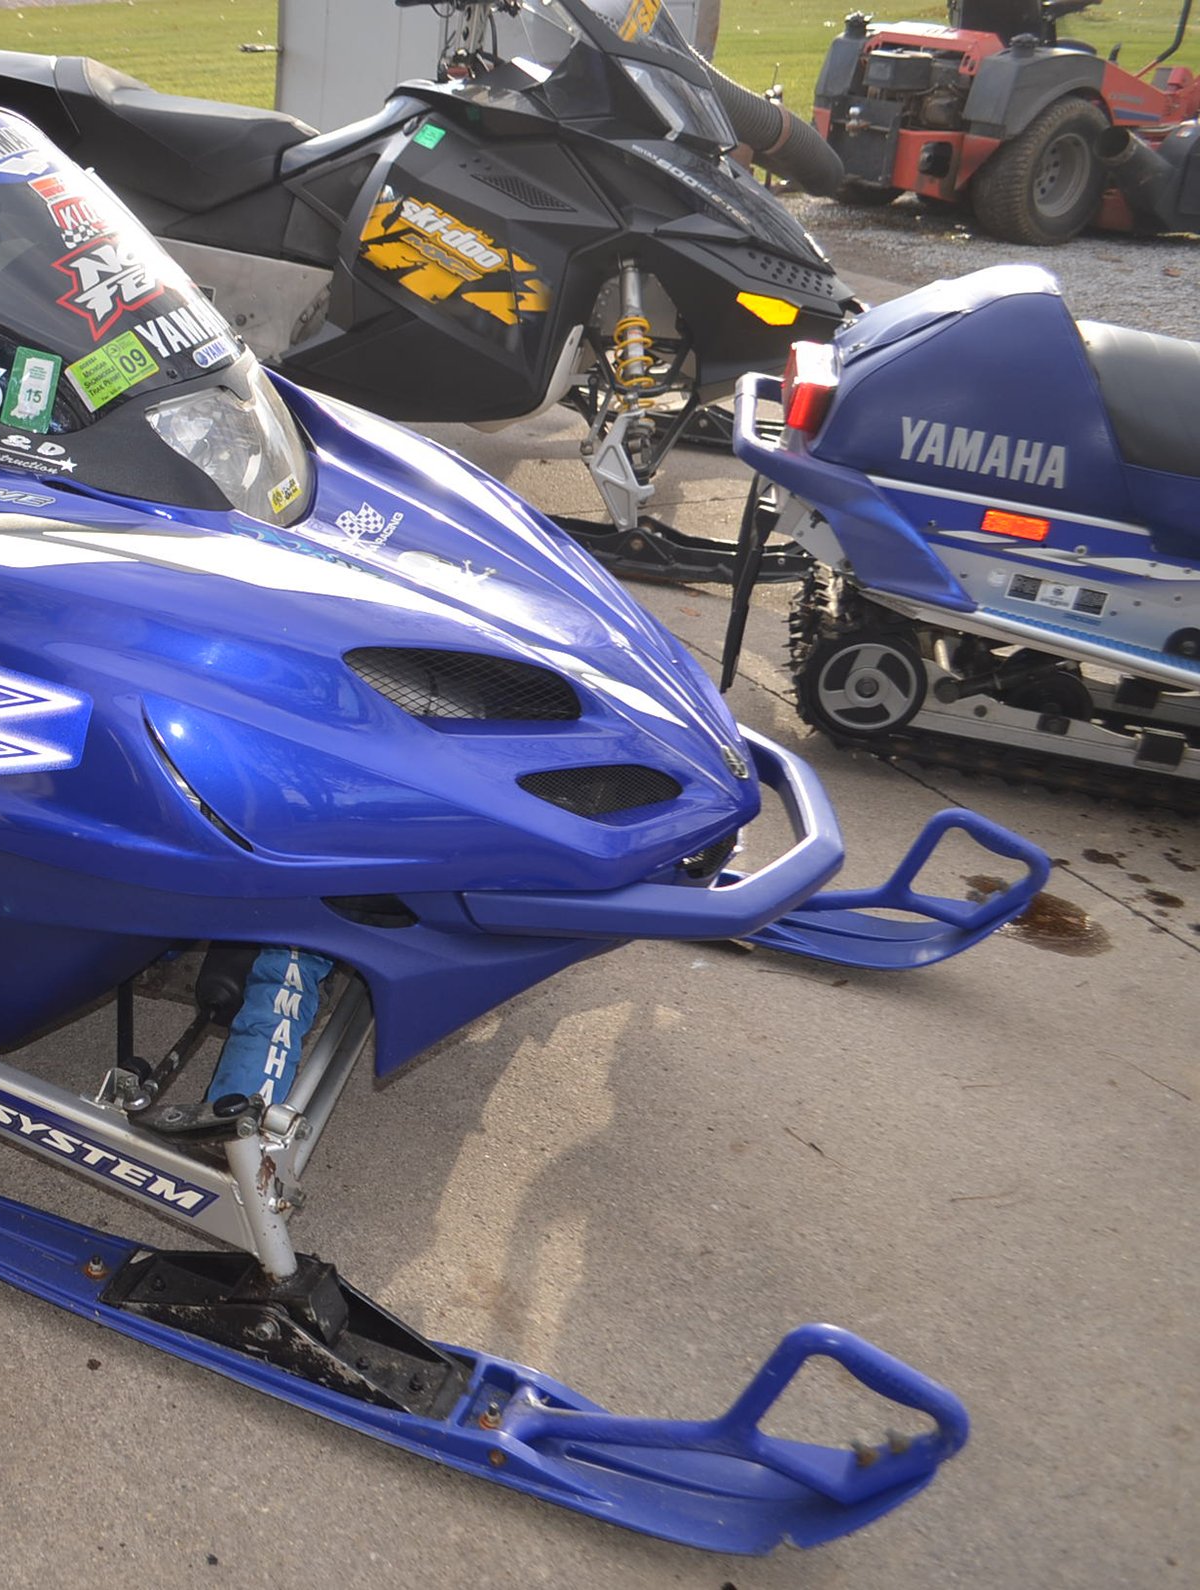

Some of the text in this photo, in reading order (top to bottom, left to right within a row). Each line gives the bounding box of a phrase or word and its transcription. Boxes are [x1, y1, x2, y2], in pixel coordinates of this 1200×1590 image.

[401, 199, 504, 269] ski-doo
[134, 303, 227, 358] YAMA
[119, 348, 147, 373] 09
[26, 388, 43, 403] 15
[1, 434, 31, 450] &
[37, 442, 66, 456] D
[900, 416, 1066, 489] YAMAHA
[375, 511, 405, 547] RACING
[259, 951, 303, 1107] AMAHA
